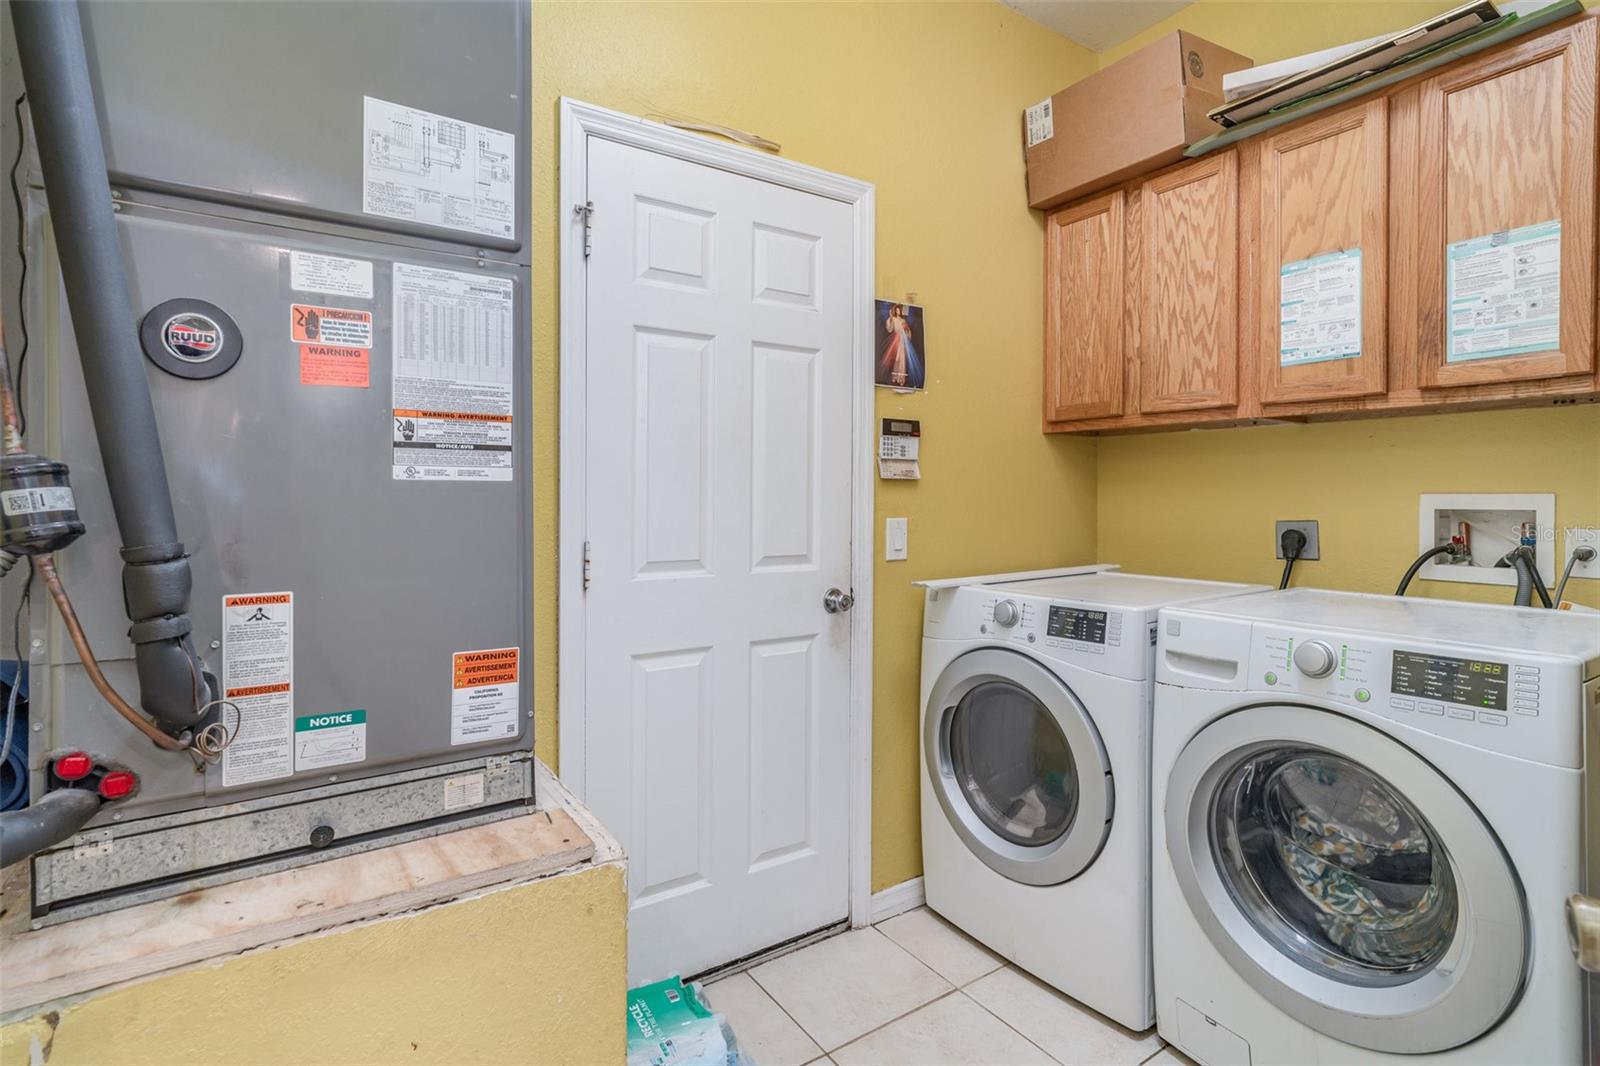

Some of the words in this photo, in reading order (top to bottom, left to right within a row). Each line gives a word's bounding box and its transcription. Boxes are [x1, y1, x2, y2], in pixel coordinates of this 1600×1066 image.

[170, 331, 215, 344] RUUD
[308, 346, 361, 358] WARNING
[239, 595, 287, 606] WARNING
[464, 651, 516, 662] WARNING
[464, 662, 516, 674] AVERTISSEMENT
[467, 673, 514, 685] ADVERTENCIA
[236, 683, 290, 697] AVERTISSEMENT
[309, 713, 353, 728] NOTICE
[629, 1003, 655, 1038] RECYCLE
